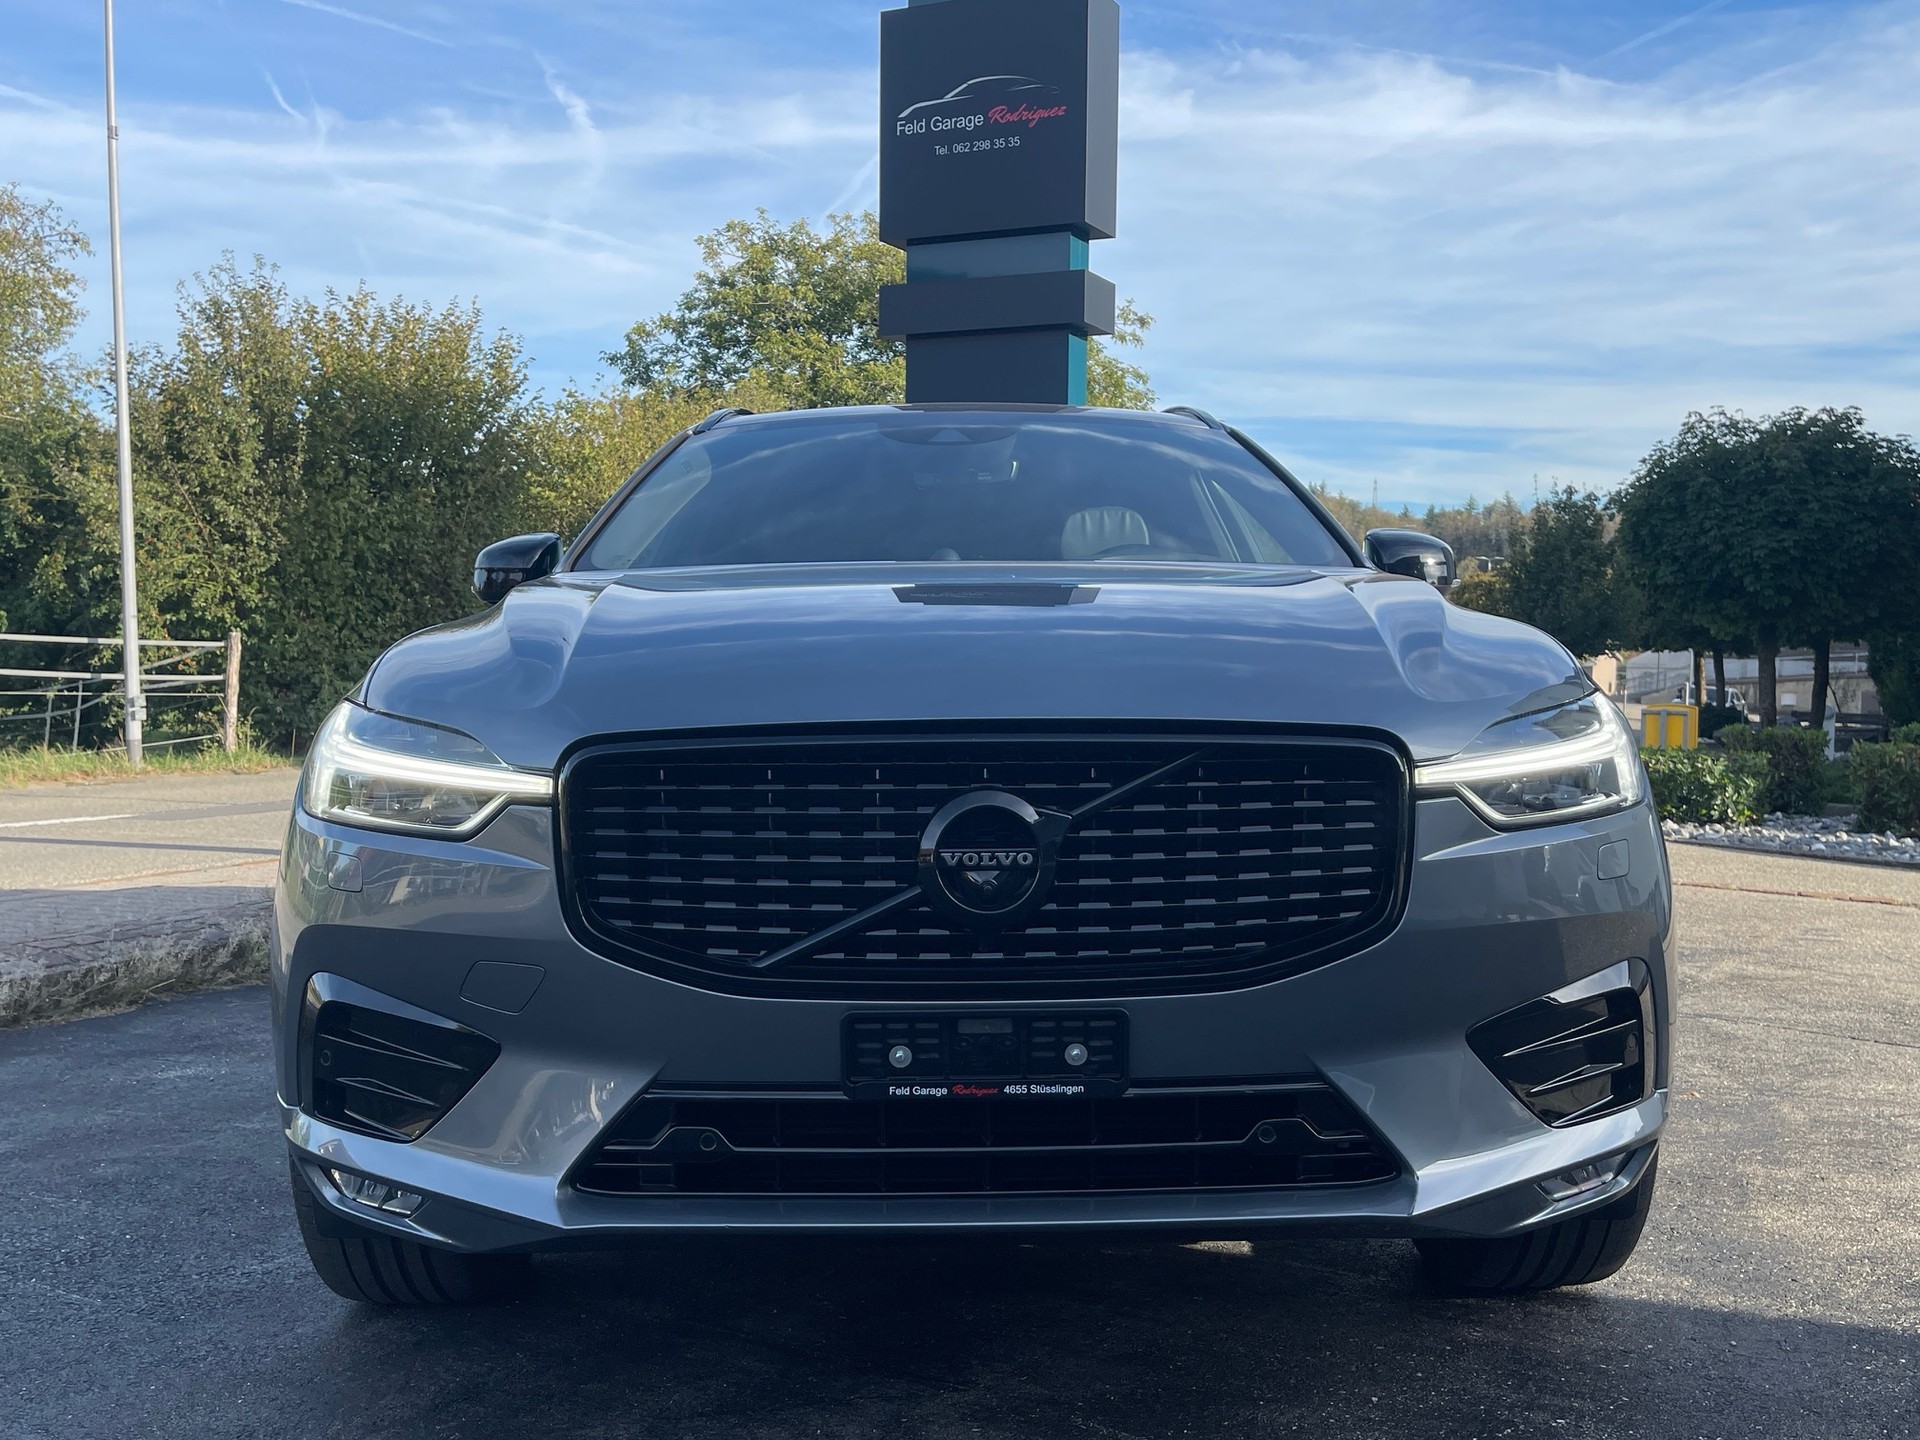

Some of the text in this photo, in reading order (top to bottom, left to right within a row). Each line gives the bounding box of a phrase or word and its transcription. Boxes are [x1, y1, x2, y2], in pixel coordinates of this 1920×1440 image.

[896, 104, 1067, 136] Feld Garage Rodriguez
[934, 136, 1021, 156] Tel. 062 298 35 35
[940, 852, 1034, 867] VOLVO
[889, 1085, 911, 1096] Feld
[912, 1085, 948, 1098] Garage
[1003, 1084, 1028, 1095] 4655
[1029, 1083, 1085, 1097] Stüsslingen
